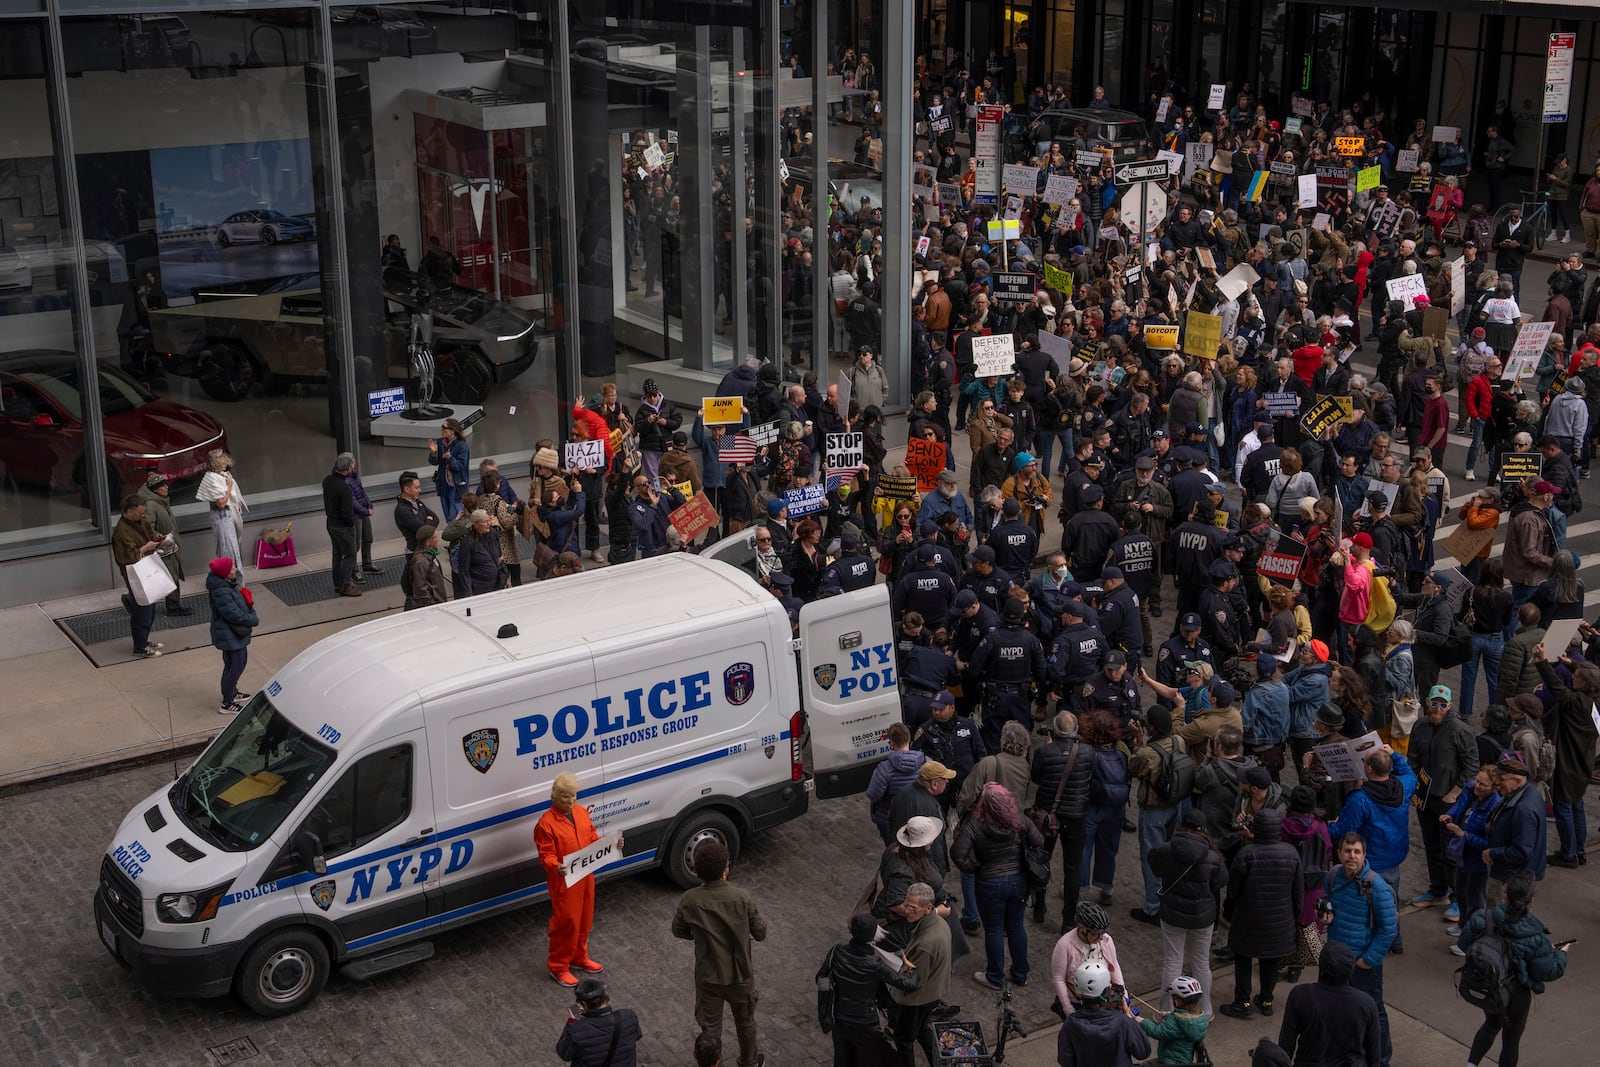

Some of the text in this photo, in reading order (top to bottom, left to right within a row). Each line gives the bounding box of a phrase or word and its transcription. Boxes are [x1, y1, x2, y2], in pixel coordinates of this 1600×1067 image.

[1338, 138, 1361, 146] STOP
[1008, 168, 1031, 177] GLOBAL
[1121, 165, 1164, 178] ONE WAY
[462, 252, 512, 267] ESLA
[999, 275, 1028, 284] DEFEND
[974, 336, 1009, 347] DEFEND
[974, 350, 1014, 360] AMERICAN
[977, 359, 996, 367] WAY
[978, 364, 1009, 374] LIFE
[369, 388, 403, 400] BILLIONAIRES
[370, 406, 390, 415] FROM
[371, 399, 404, 410] STEALING
[1305, 400, 1333, 425] WTF?
[1312, 409, 1343, 436] MUSK
[748, 427, 759, 436] THIS
[765, 423, 774, 431] THE
[768, 435, 778, 444] JOB
[827, 433, 862, 450] STOP
[567, 440, 601, 457] NAZI
[907, 439, 943, 458] SEND
[568, 456, 601, 471] SCUM
[827, 453, 862, 468] COUP
[905, 455, 938, 468] ELON
[1264, 458, 1280, 470] NYP
[879, 475, 915, 484] OVERTHROW
[786, 486, 822, 497] YOU WILL
[884, 489, 913, 497] RESIDENT
[789, 495, 804, 503] PAY
[675, 498, 702, 521] NO ONE
[789, 508, 804, 516] TAX
[684, 514, 708, 534] MUSK
[1007, 535, 1026, 544] NYPD
[1179, 531, 1207, 551] NYPD
[1123, 541, 1153, 554] NYPD
[851, 562, 868, 573] NYPD
[1261, 555, 1299, 575] FASCIST
[917, 579, 939, 587] NYPD
[1080, 639, 1096, 650] NYPD
[1000, 647, 1024, 656] NYPD
[727, 663, 751, 678] POLICE
[266, 680, 283, 697] NYPD
[513, 671, 712, 756] POLICE
[317, 723, 342, 744] NYPD
[761, 734, 775, 746] 1959
[532, 715, 698, 770] STRATEGIC RESPONSE GROUP
[728, 744, 742, 755] SRG
[857, 744, 895, 760] KEEP BAC
[586, 797, 628, 815] COURTESY
[591, 800, 651, 822] OFESSIONALISM
[127, 840, 152, 864] NYPD
[570, 843, 612, 874] FELON
[112, 845, 145, 881] POLICE
[345, 838, 474, 905] NYPD
[234, 881, 278, 903] POLICE
